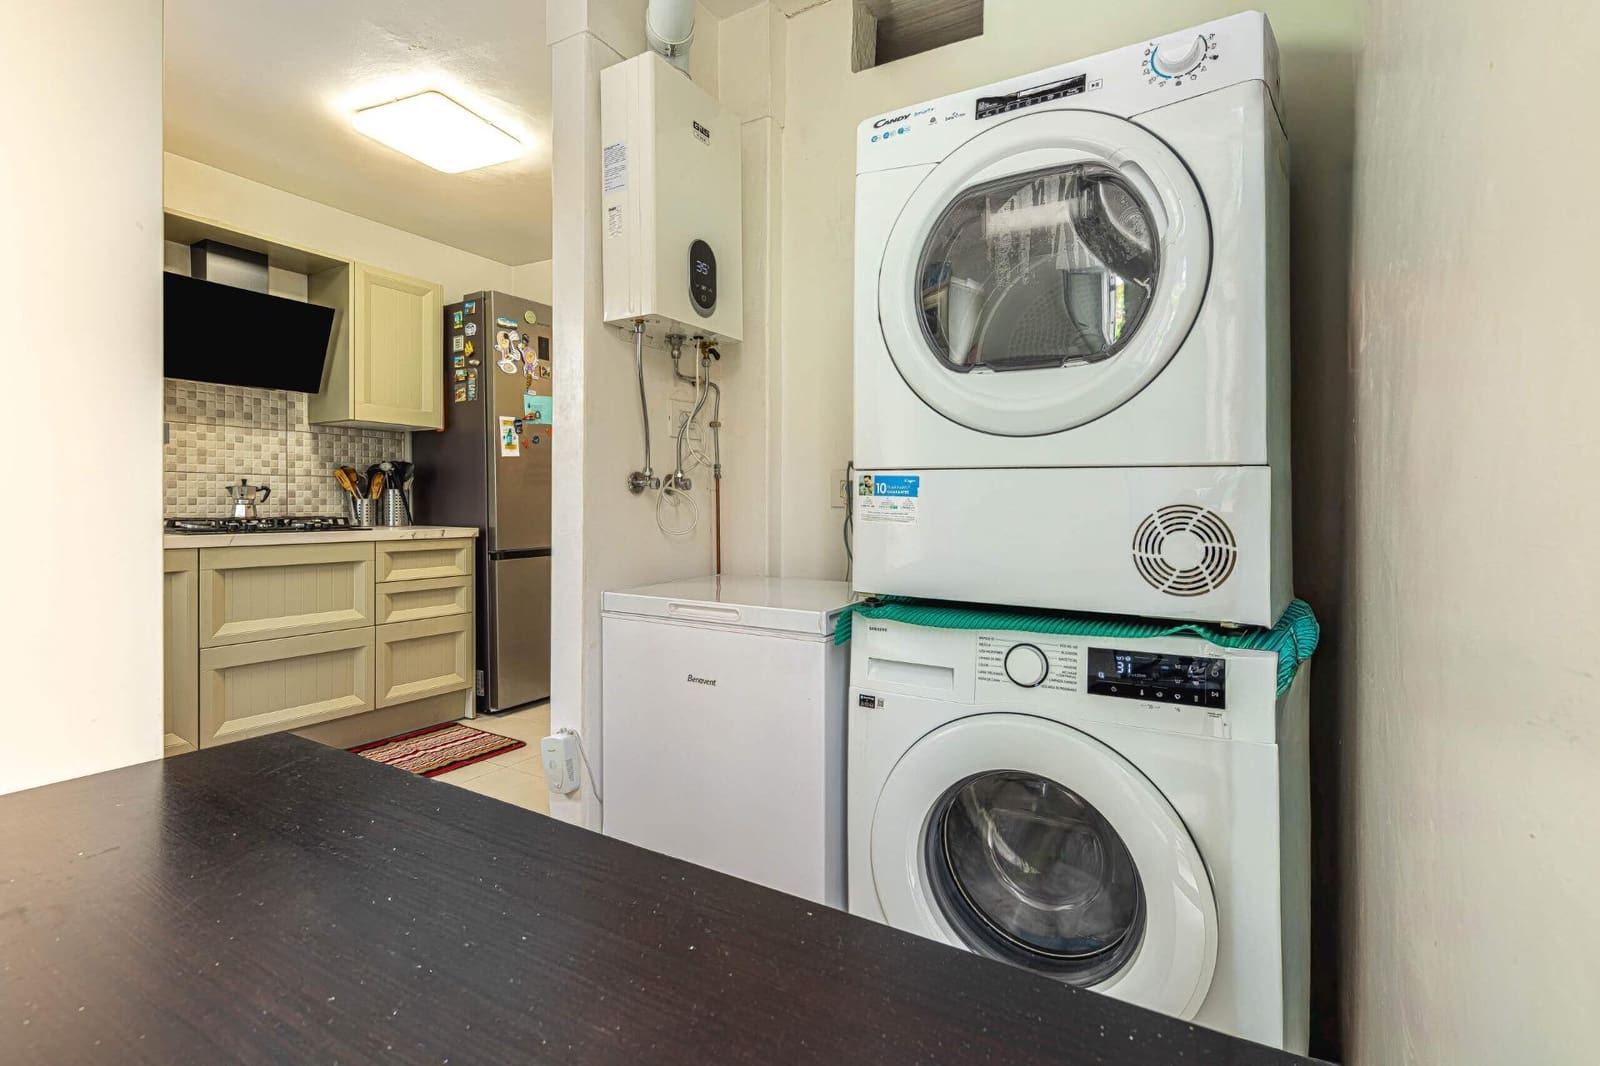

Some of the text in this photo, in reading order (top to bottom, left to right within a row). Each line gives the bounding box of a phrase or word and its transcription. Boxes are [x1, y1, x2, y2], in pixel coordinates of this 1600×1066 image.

[873, 113, 911, 129] CANDY
[875, 482, 887, 494] 10
[1117, 661, 1131, 674] 31
